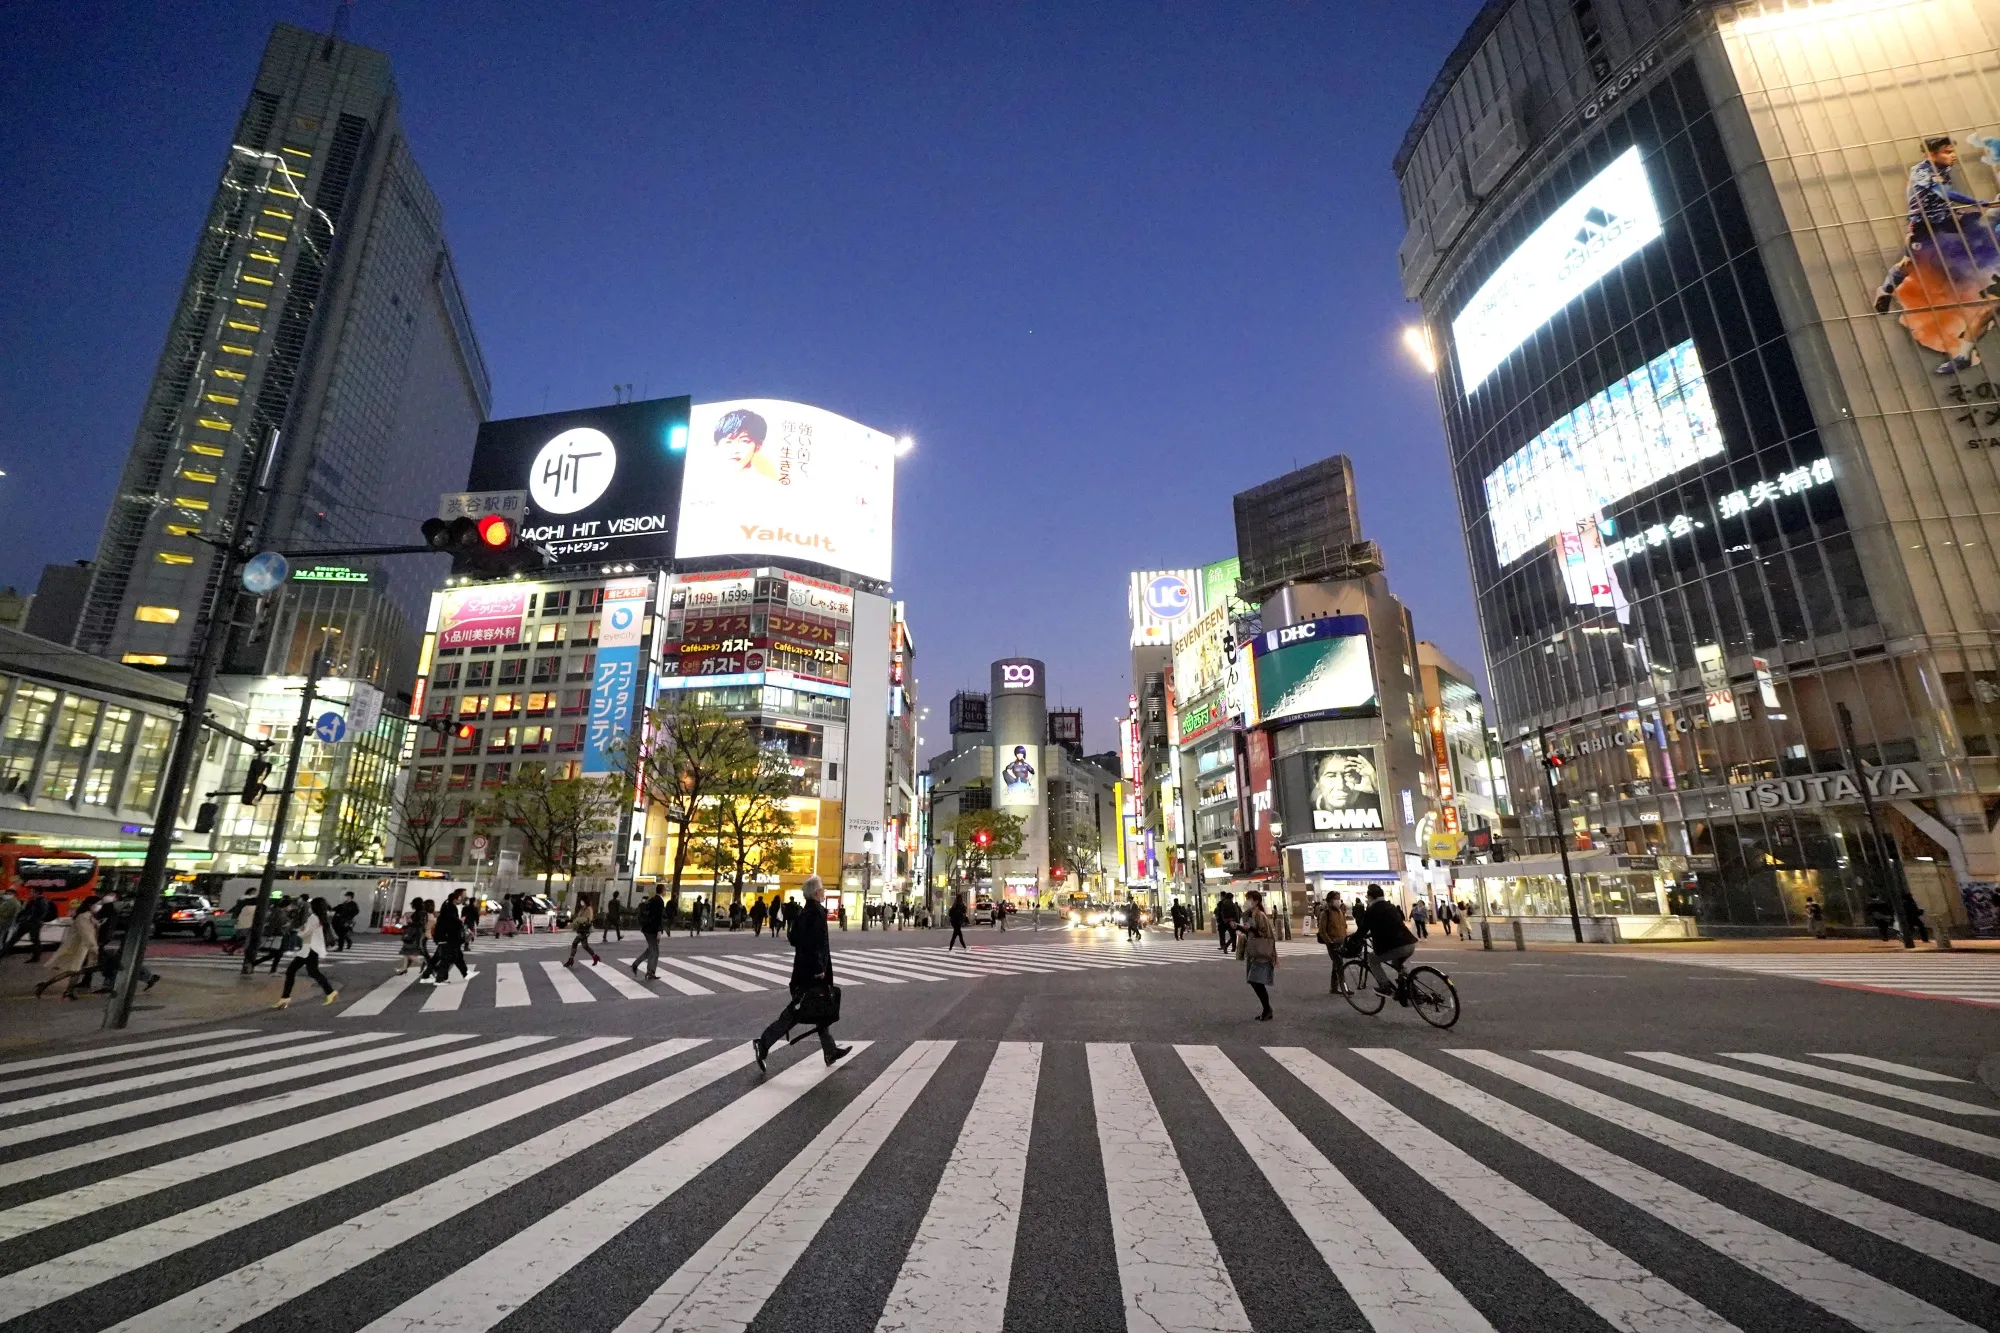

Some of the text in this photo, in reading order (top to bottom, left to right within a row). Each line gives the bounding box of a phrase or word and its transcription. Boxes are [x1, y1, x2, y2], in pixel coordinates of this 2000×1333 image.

[1557, 217, 1638, 282] adidas
[447, 495, 519, 513] 渋谷駅前
[572, 521, 600, 537] HIT
[607, 515, 666, 534] VISION
[740, 525, 837, 553] Yakult
[295, 570, 368, 579] MARK CITY
[672, 593, 686, 603] 9F
[721, 589, 753, 604] 1,599円
[1148, 584, 1189, 608] UC
[480, 602, 517, 614] クリニック
[685, 616, 748, 633] プライス
[768, 616, 833, 641] コンタクト
[1174, 605, 1224, 657] SEVENTEEN
[1280, 622, 1316, 643] DHC
[450, 626, 516, 643] 品川美容外科
[603, 631, 636, 642] eyecity
[721, 638, 754, 652] ガスト
[664, 661, 679, 672] 7F
[701, 656, 741, 674] ガスト
[813, 648, 844, 664] ガスト
[1001, 664, 1035, 688] 109
[591, 662, 618, 752] アイシティ
[1733, 767, 1921, 810] TSUTAYA
[1312, 808, 1383, 830] DMM
